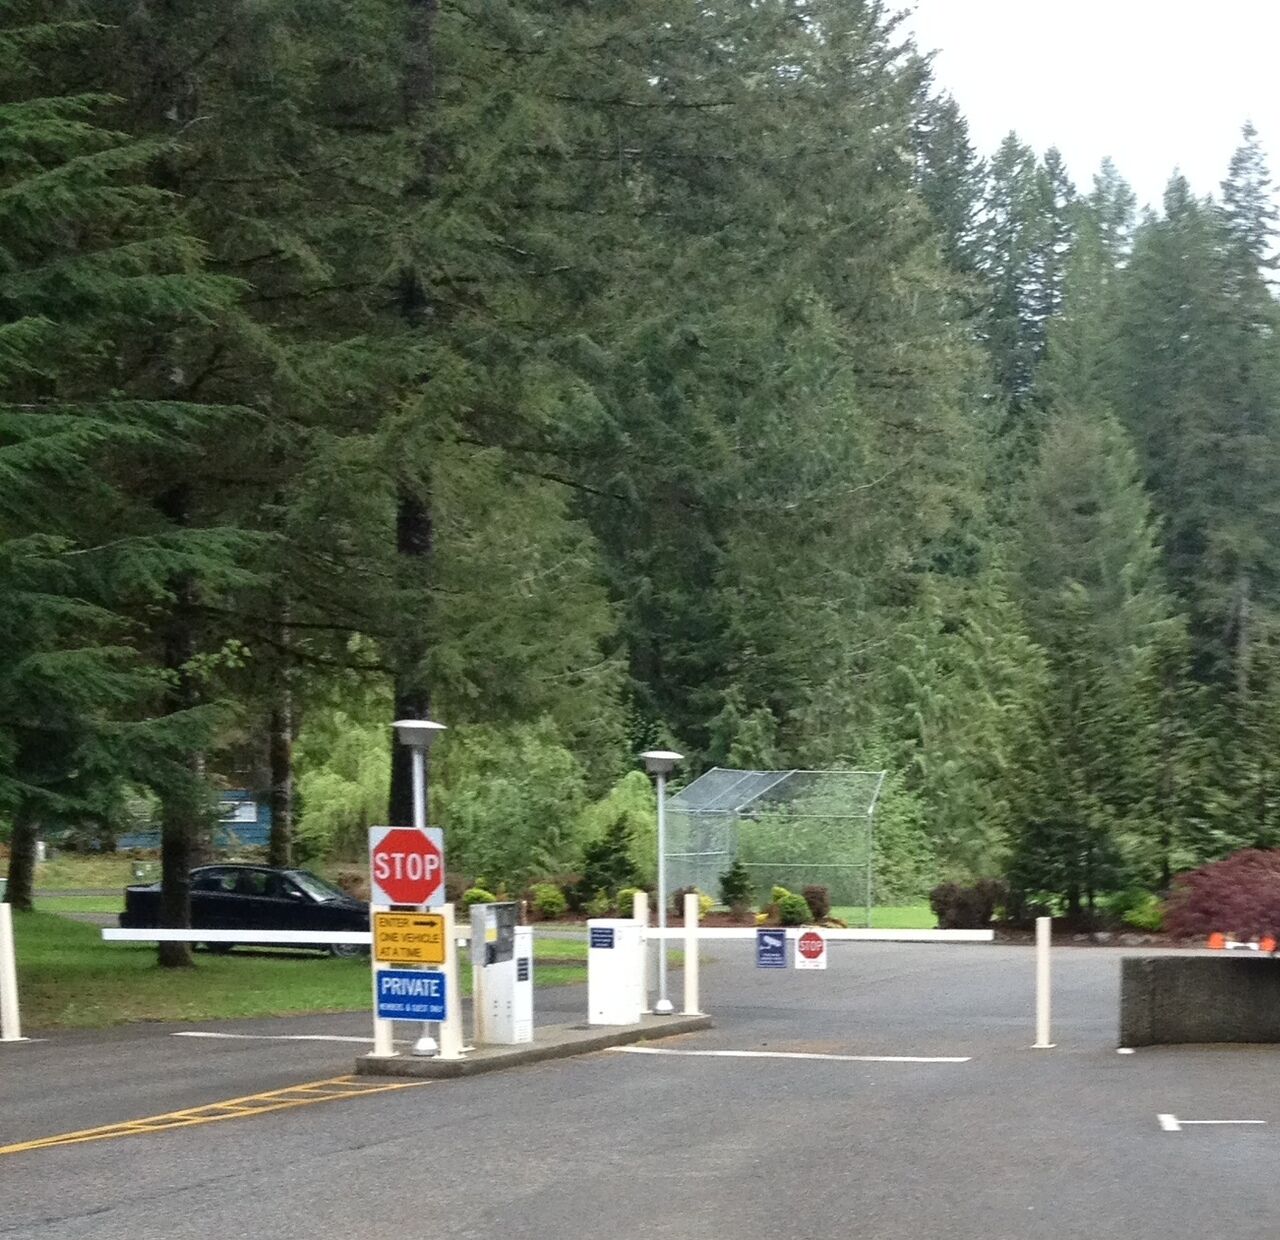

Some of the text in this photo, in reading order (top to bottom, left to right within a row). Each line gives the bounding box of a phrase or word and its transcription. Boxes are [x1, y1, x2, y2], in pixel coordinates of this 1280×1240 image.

[375, 852, 440, 880] STOP
[379, 917, 409, 928] ENTER
[380, 932, 440, 944] ONE VEHICLE
[380, 946, 421, 958] AT A TIME
[800, 940, 822, 952] STOP
[381, 977, 441, 997] PRIVATE
